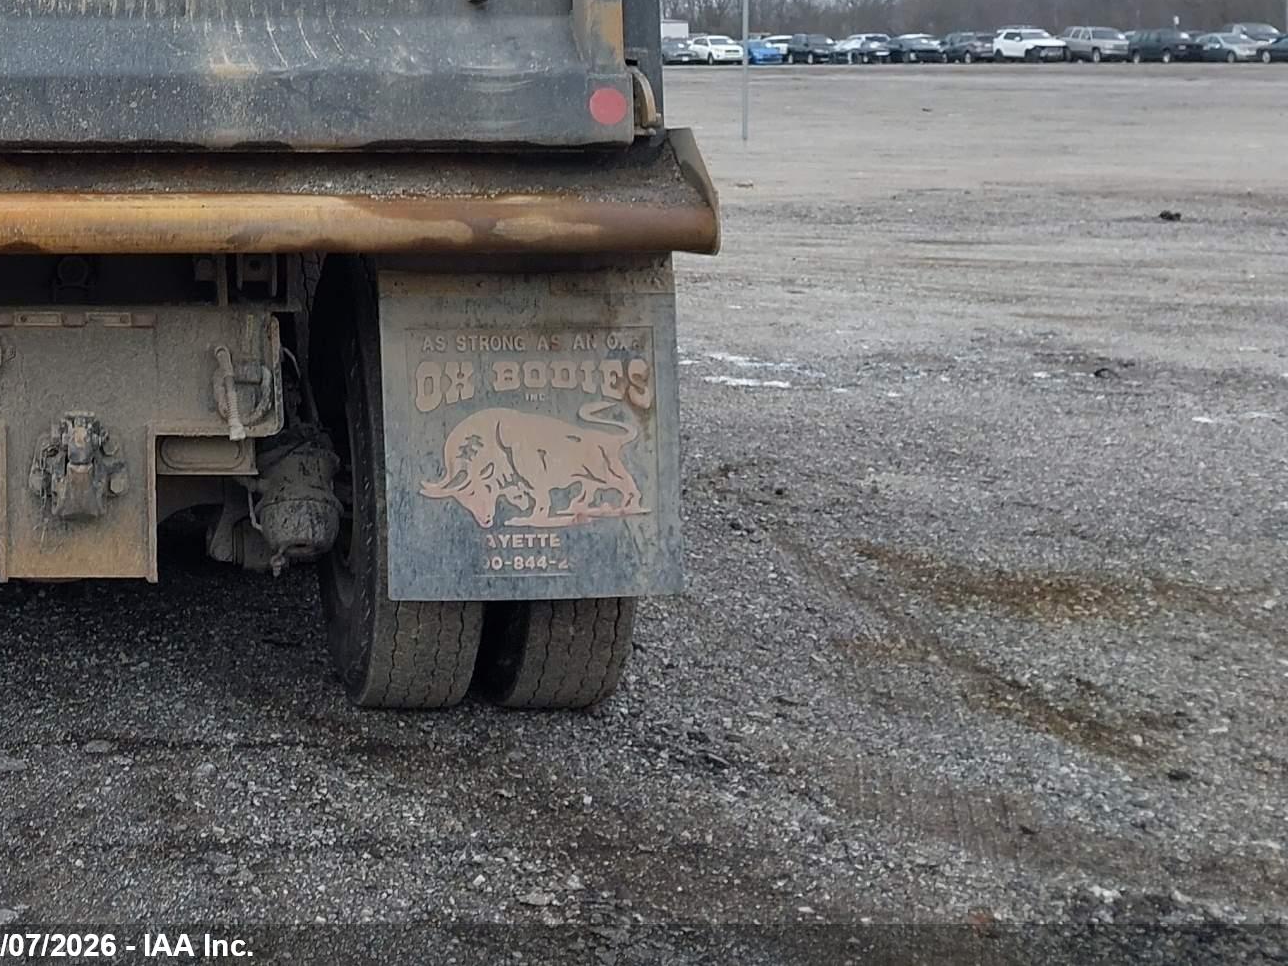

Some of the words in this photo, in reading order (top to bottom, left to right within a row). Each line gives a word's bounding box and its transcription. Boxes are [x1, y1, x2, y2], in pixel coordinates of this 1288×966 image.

[422, 335, 446, 352] AS
[456, 335, 526, 352] STRONG
[537, 335, 561, 351] AS
[573, 334, 597, 350] AN
[415, 360, 475, 412] OX
[492, 358, 652, 409] BODIES
[525, 393, 546, 402] INC
